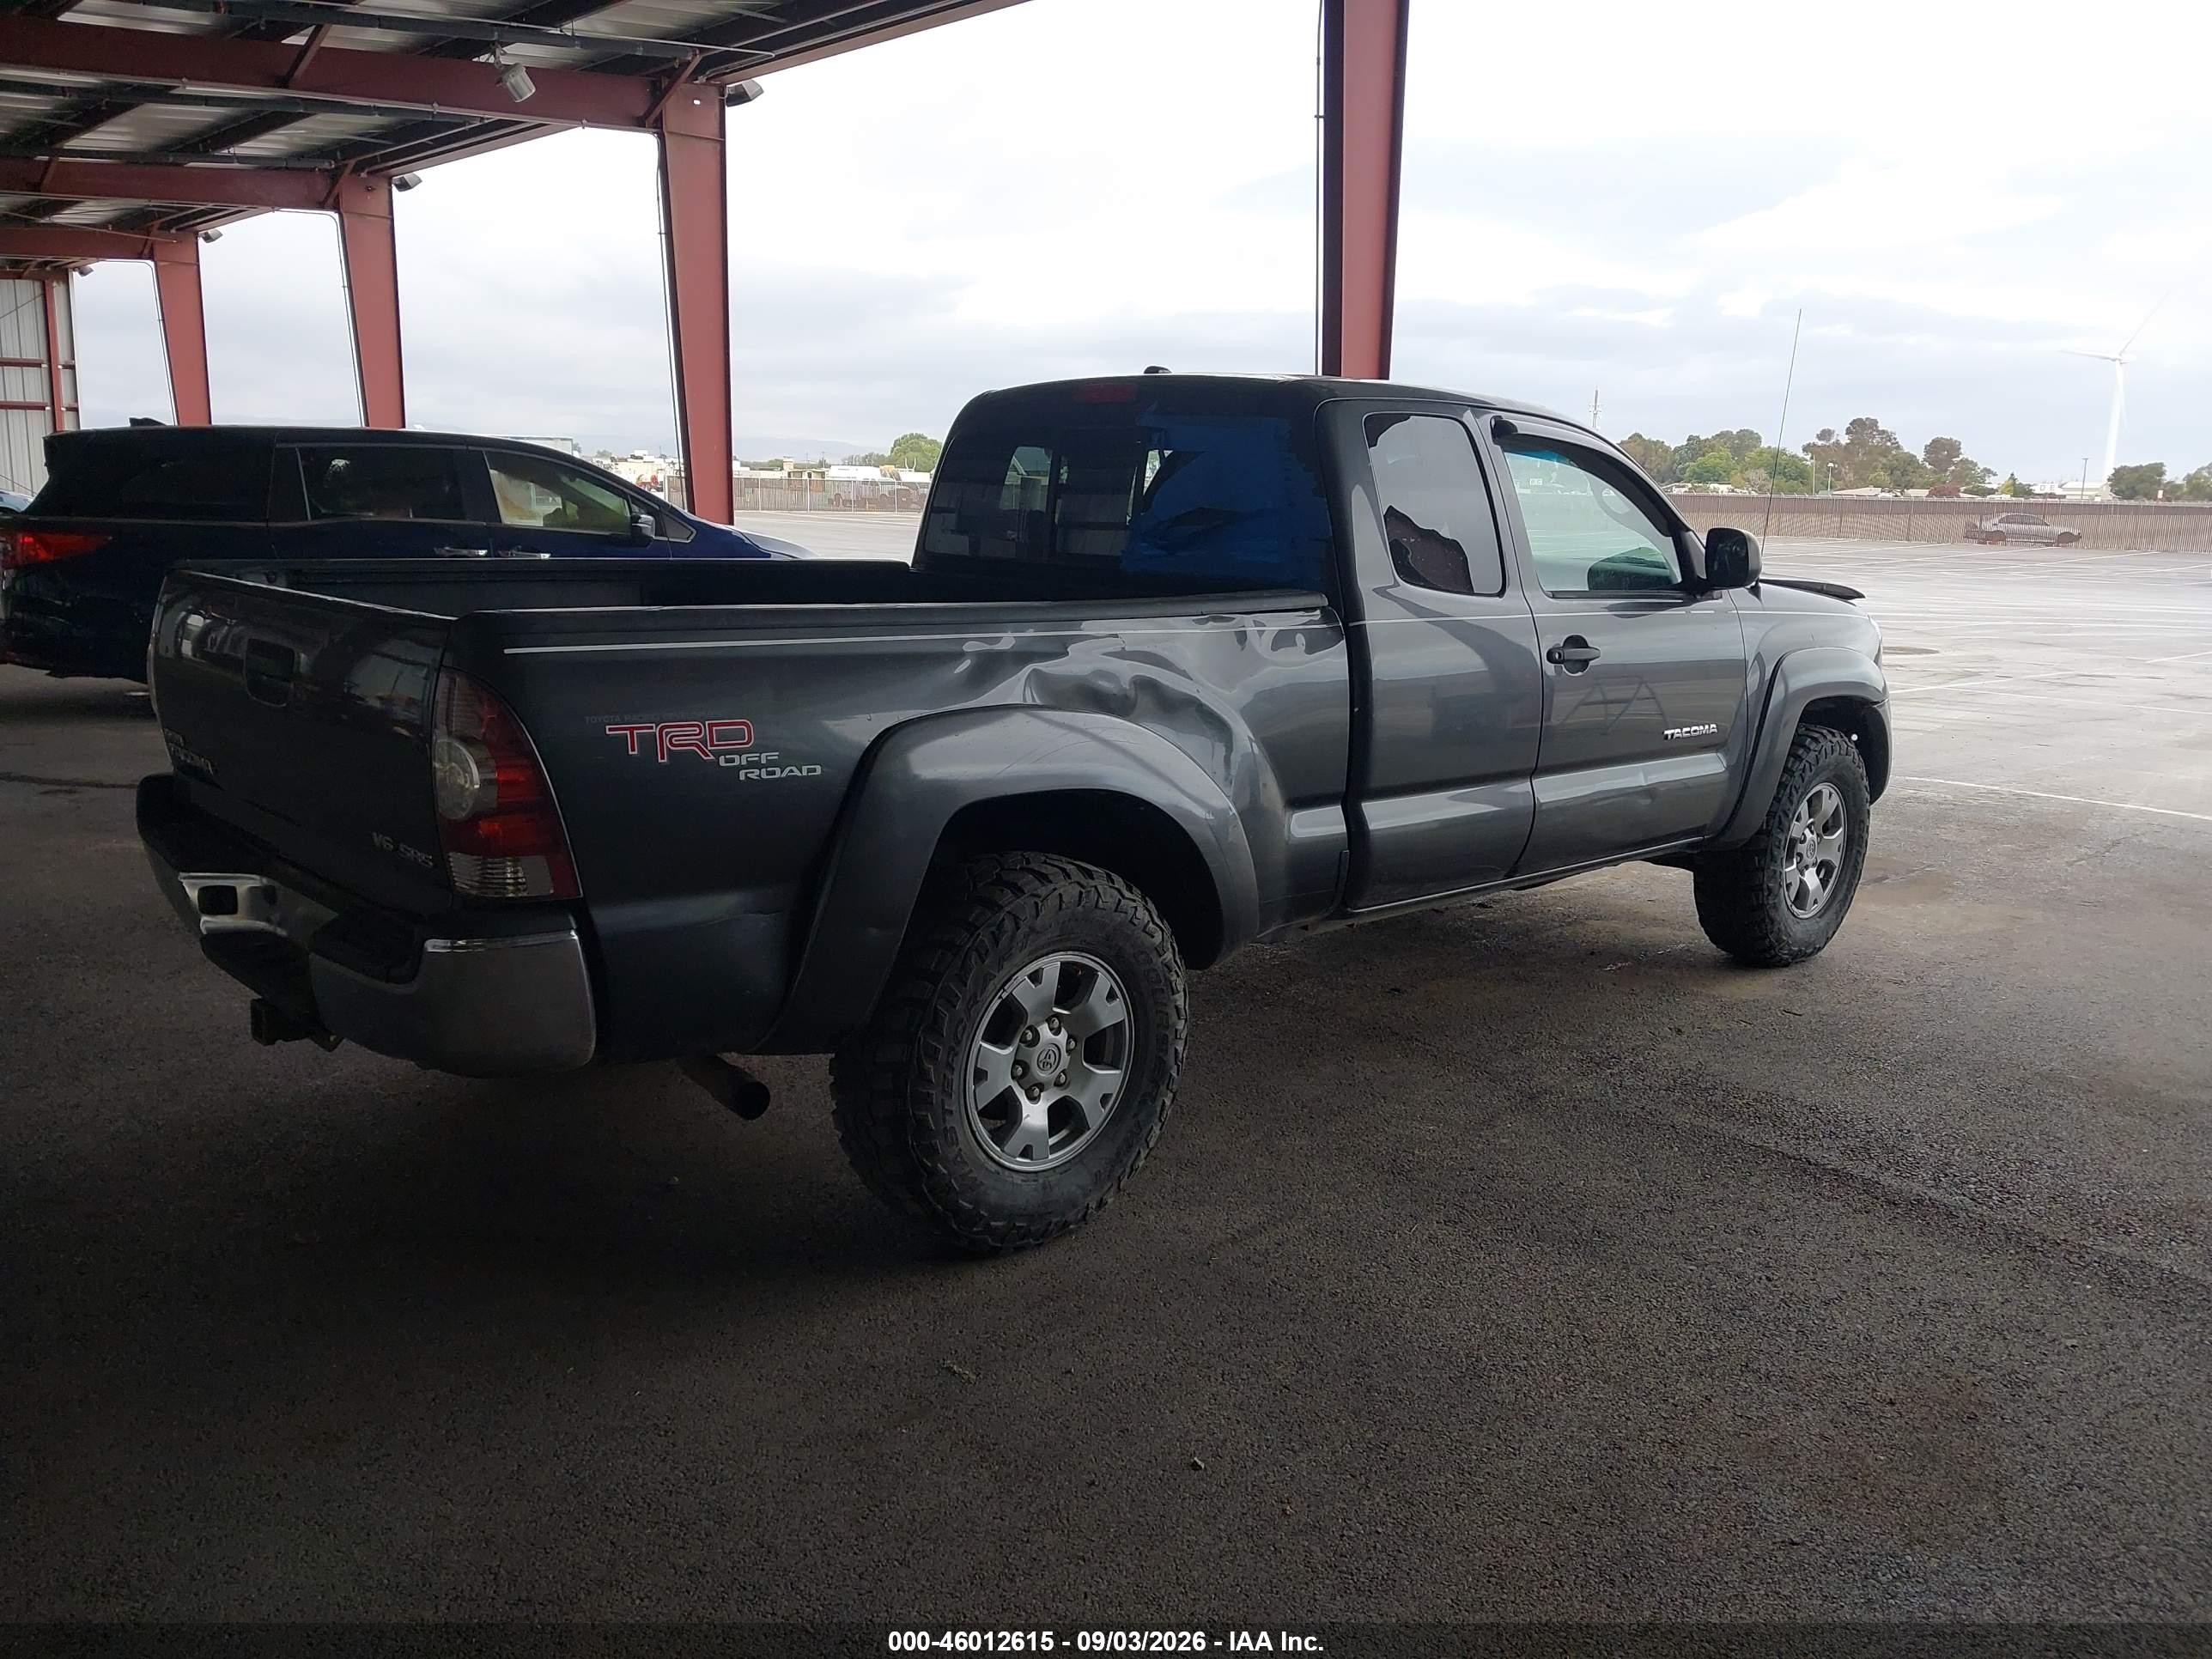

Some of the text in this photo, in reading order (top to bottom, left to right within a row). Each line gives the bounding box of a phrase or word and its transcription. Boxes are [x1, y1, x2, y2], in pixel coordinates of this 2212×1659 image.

[1663, 724, 1718, 740] TACOMA
[605, 720, 755, 763] TRD
[718, 752, 780, 767] OFF
[739, 764, 822, 781] ROAD
[372, 831, 394, 852] V6
